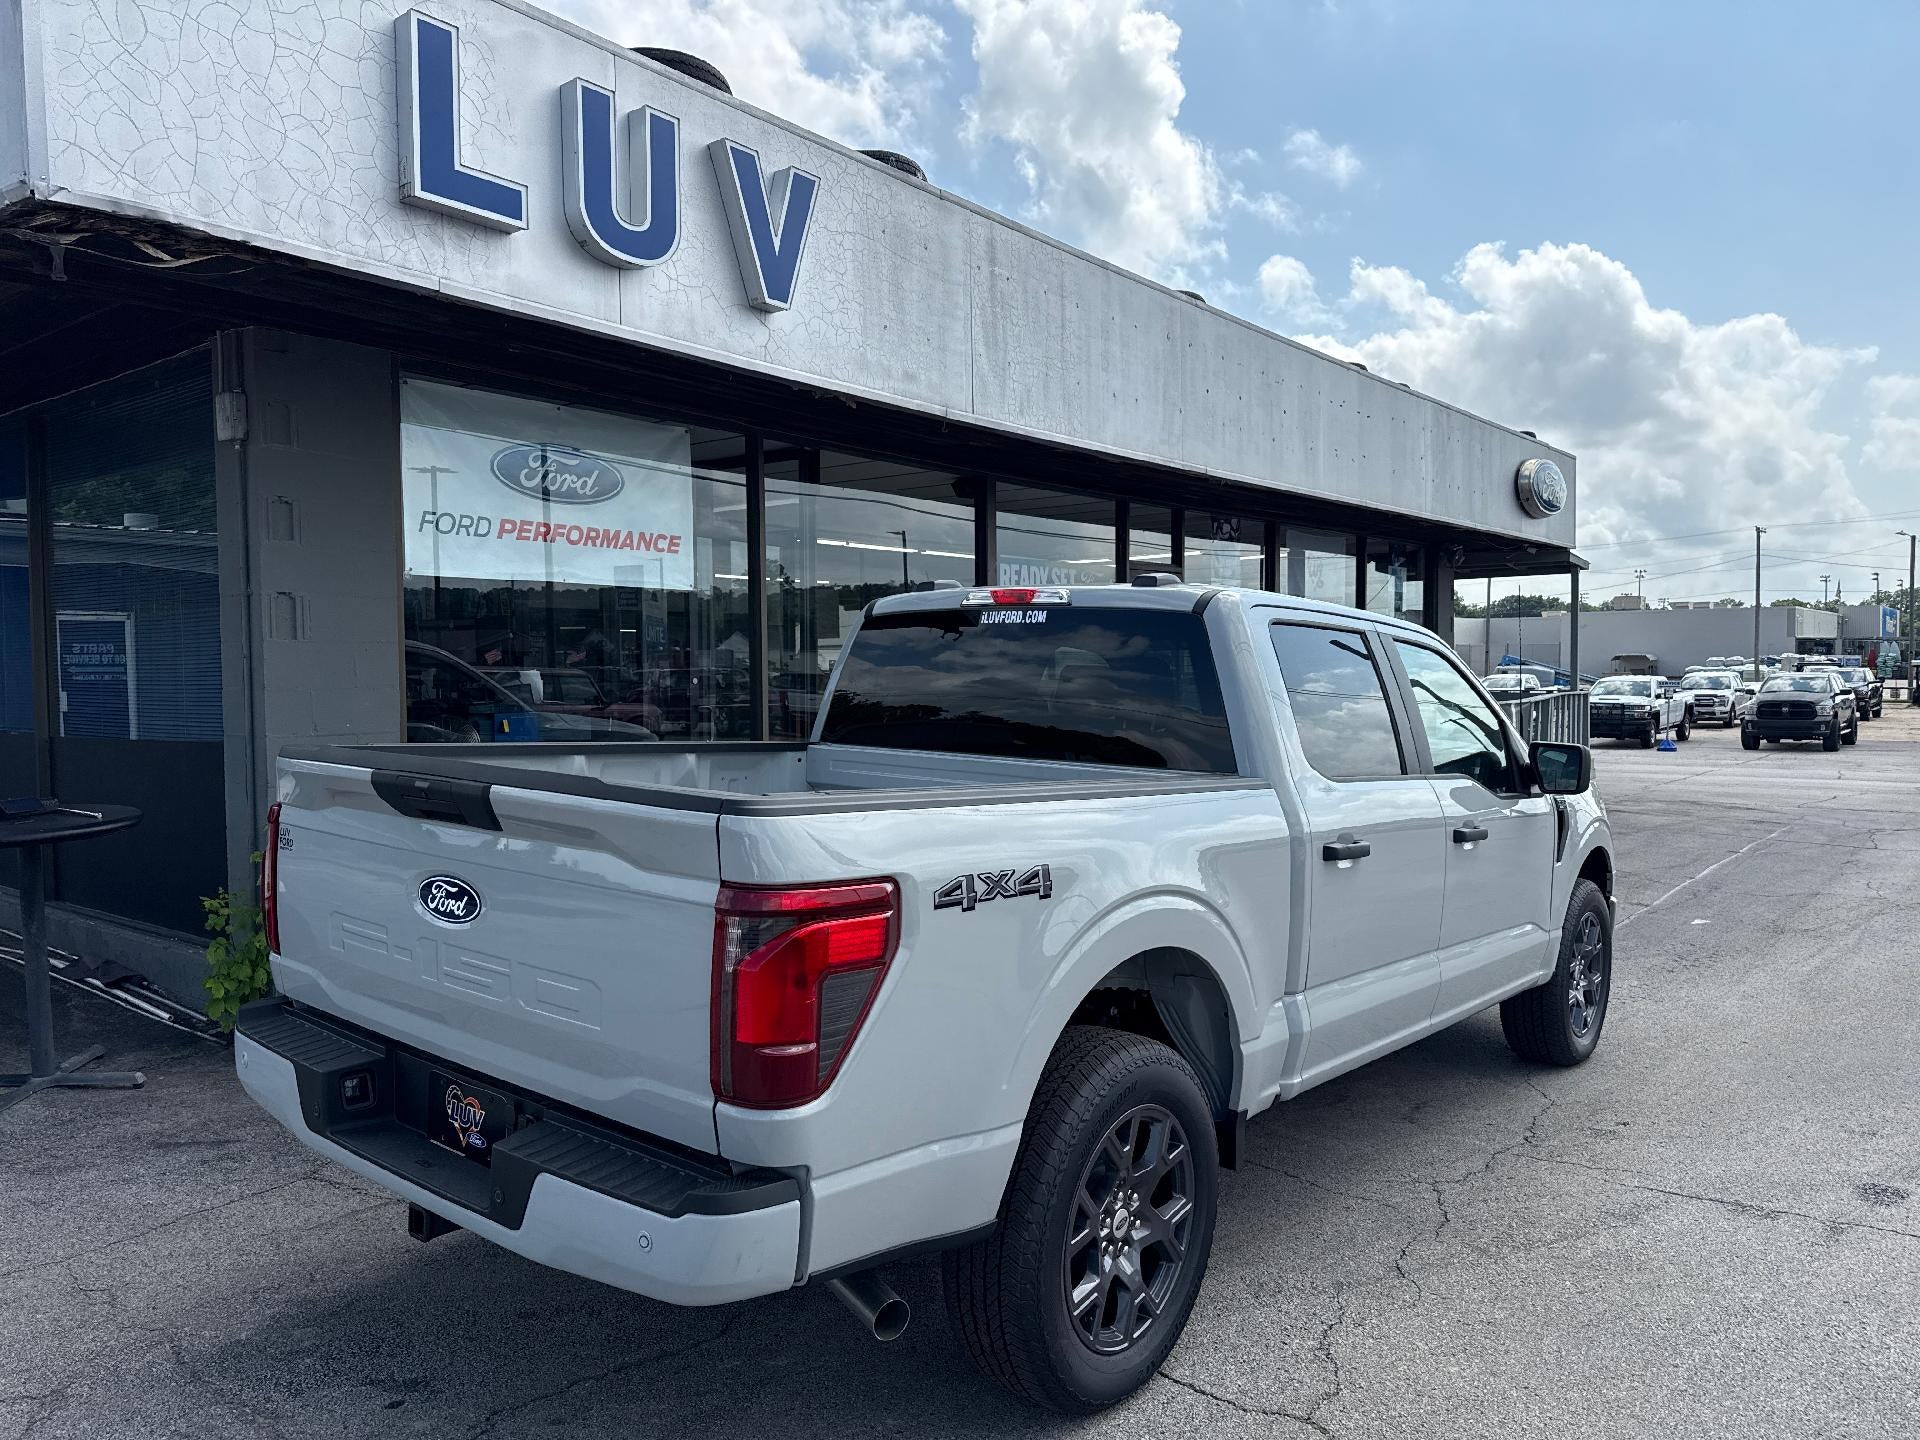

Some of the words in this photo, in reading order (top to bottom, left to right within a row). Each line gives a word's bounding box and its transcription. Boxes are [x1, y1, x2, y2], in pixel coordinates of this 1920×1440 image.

[394, 8, 821, 313] LUV
[520, 450, 599, 496] Ford
[418, 510, 492, 538] FORD
[496, 518, 682, 555] PERFORMANCE
[999, 563, 1049, 586] READY
[1051, 567, 1076, 585] SET
[427, 881, 468, 917] Ford
[330, 910, 602, 1030] F-150
